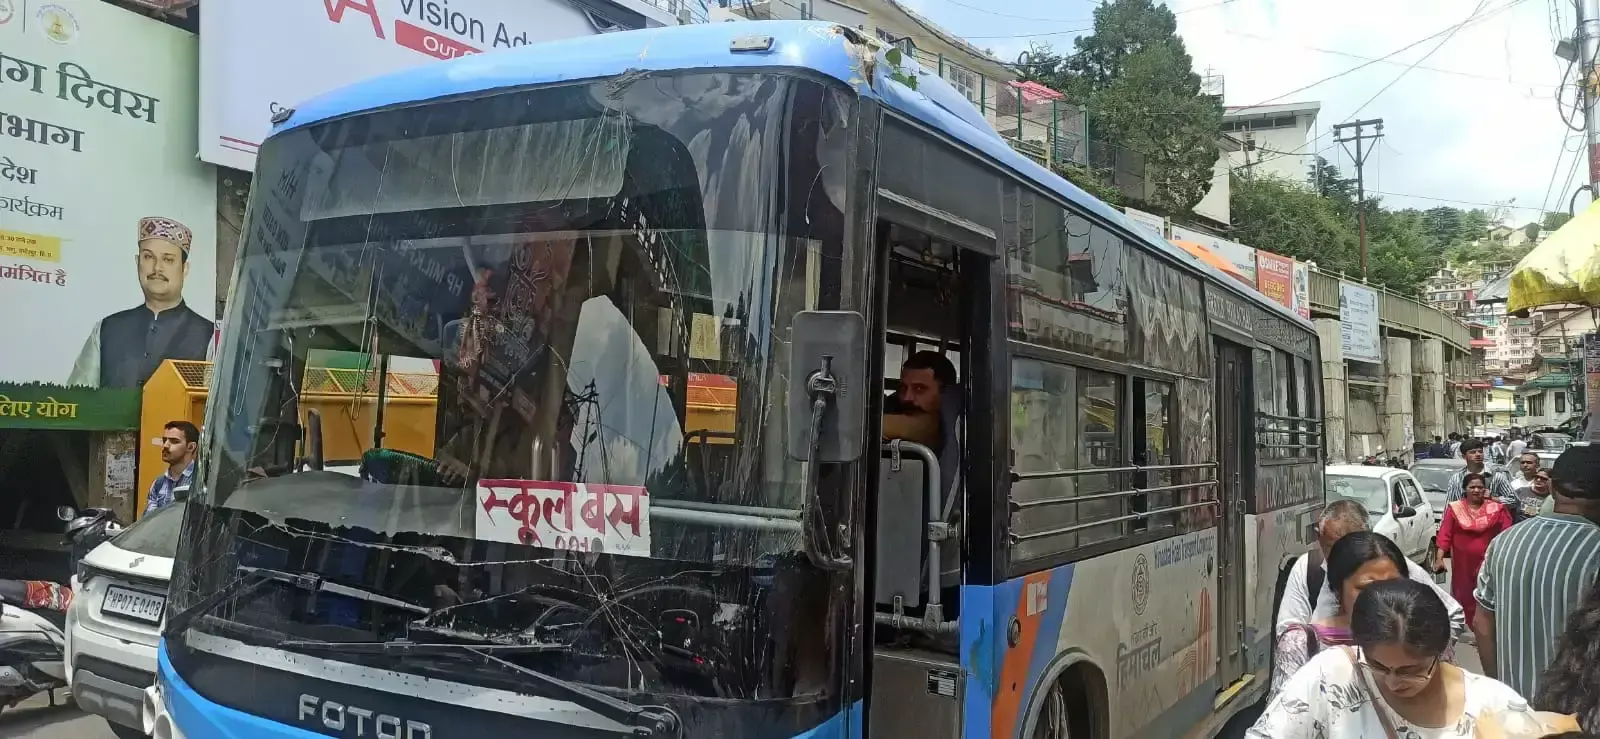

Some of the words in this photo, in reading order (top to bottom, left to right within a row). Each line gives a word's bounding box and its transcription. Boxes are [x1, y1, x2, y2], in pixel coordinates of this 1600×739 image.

[493, 21, 532, 48] Ad
[56, 62, 160, 123] दिवस
[55, 268, 67, 287] है
[36, 396, 79, 418] योग
[479, 479, 578, 546] स्कूल
[584, 483, 648, 541] बस
